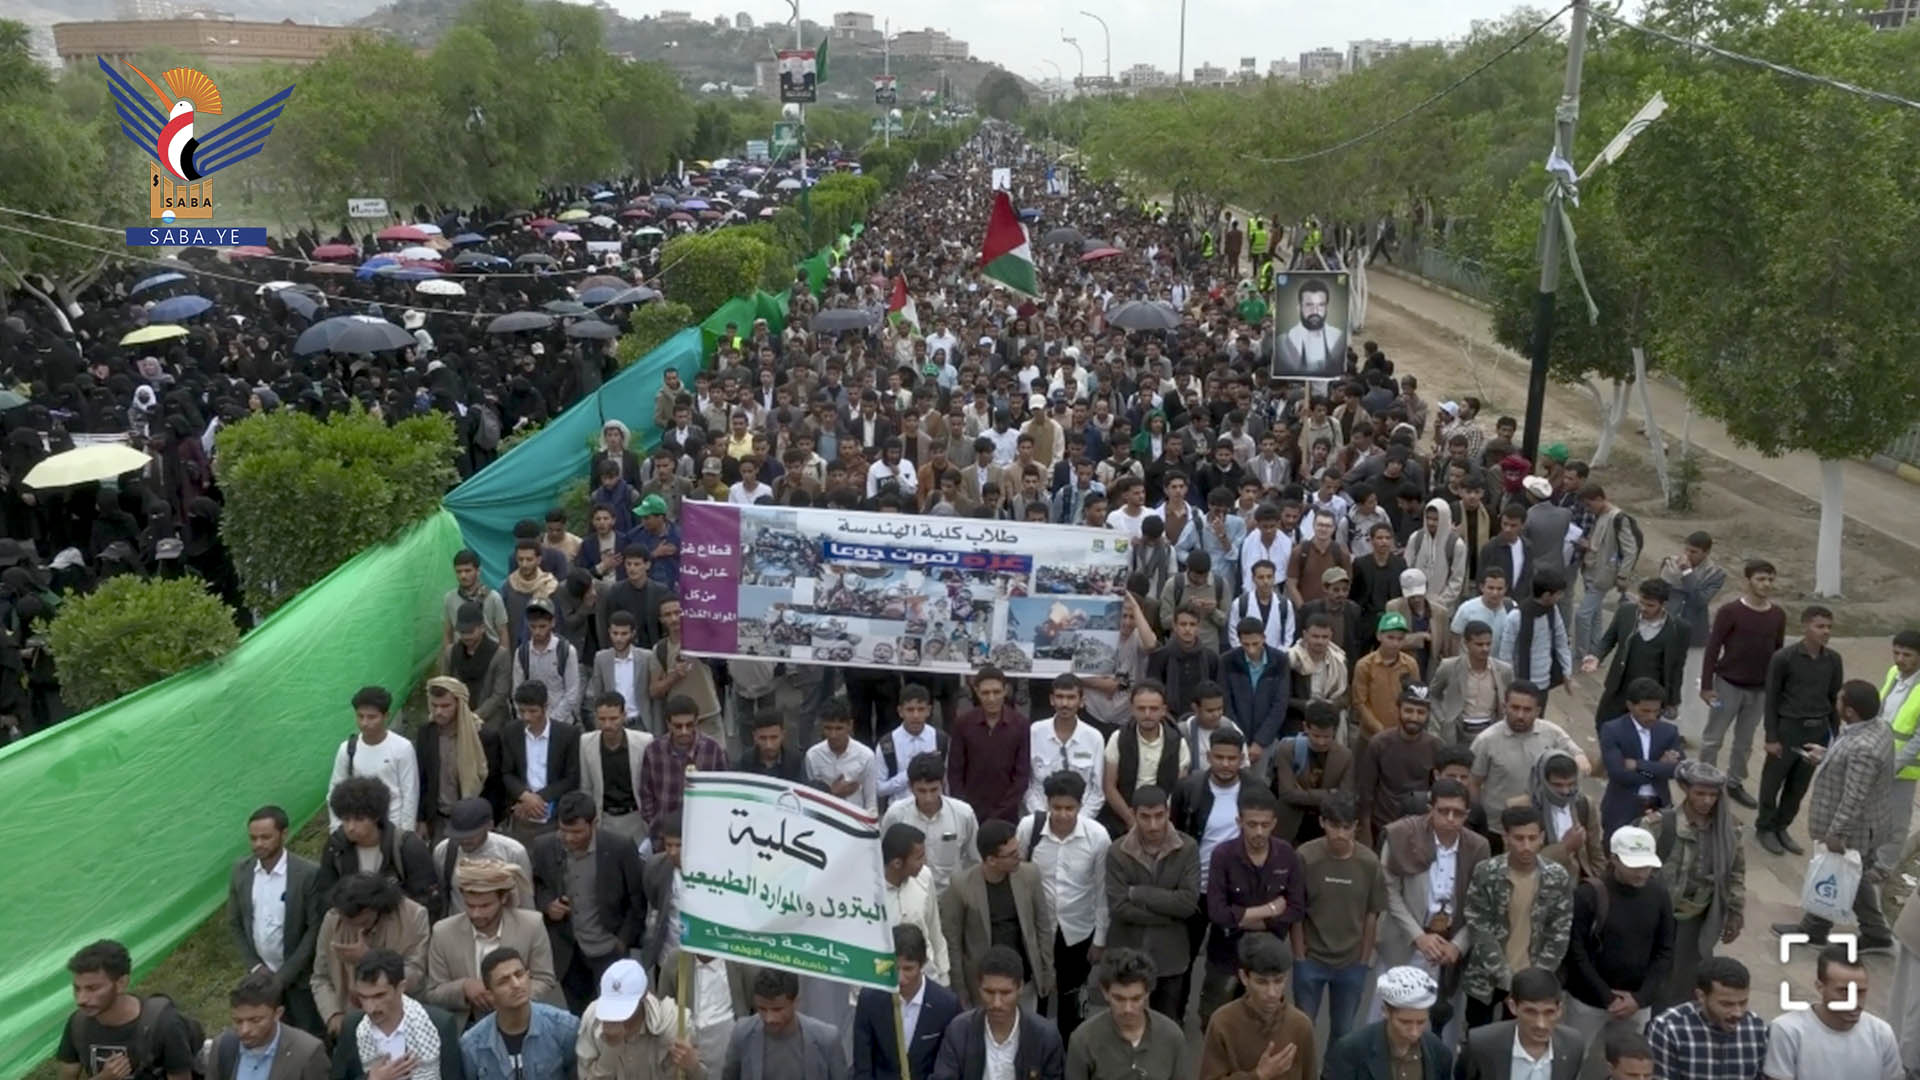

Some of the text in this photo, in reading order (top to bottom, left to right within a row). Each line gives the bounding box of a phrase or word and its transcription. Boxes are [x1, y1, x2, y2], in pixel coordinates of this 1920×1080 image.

[837, 517, 1019, 547] طلاب كلية الهندسة
[680, 541, 732, 558] قطاع غز
[830, 542, 886, 561] جوعا
[890, 546, 960, 565] تموت
[679, 564, 699, 576] تما
[684, 588, 717, 602] من كل
[728, 807, 828, 871] كلية
[681, 866, 889, 924] البترول والموارد الطبيعي
[705, 926, 851, 965] جامعة صنعاء
